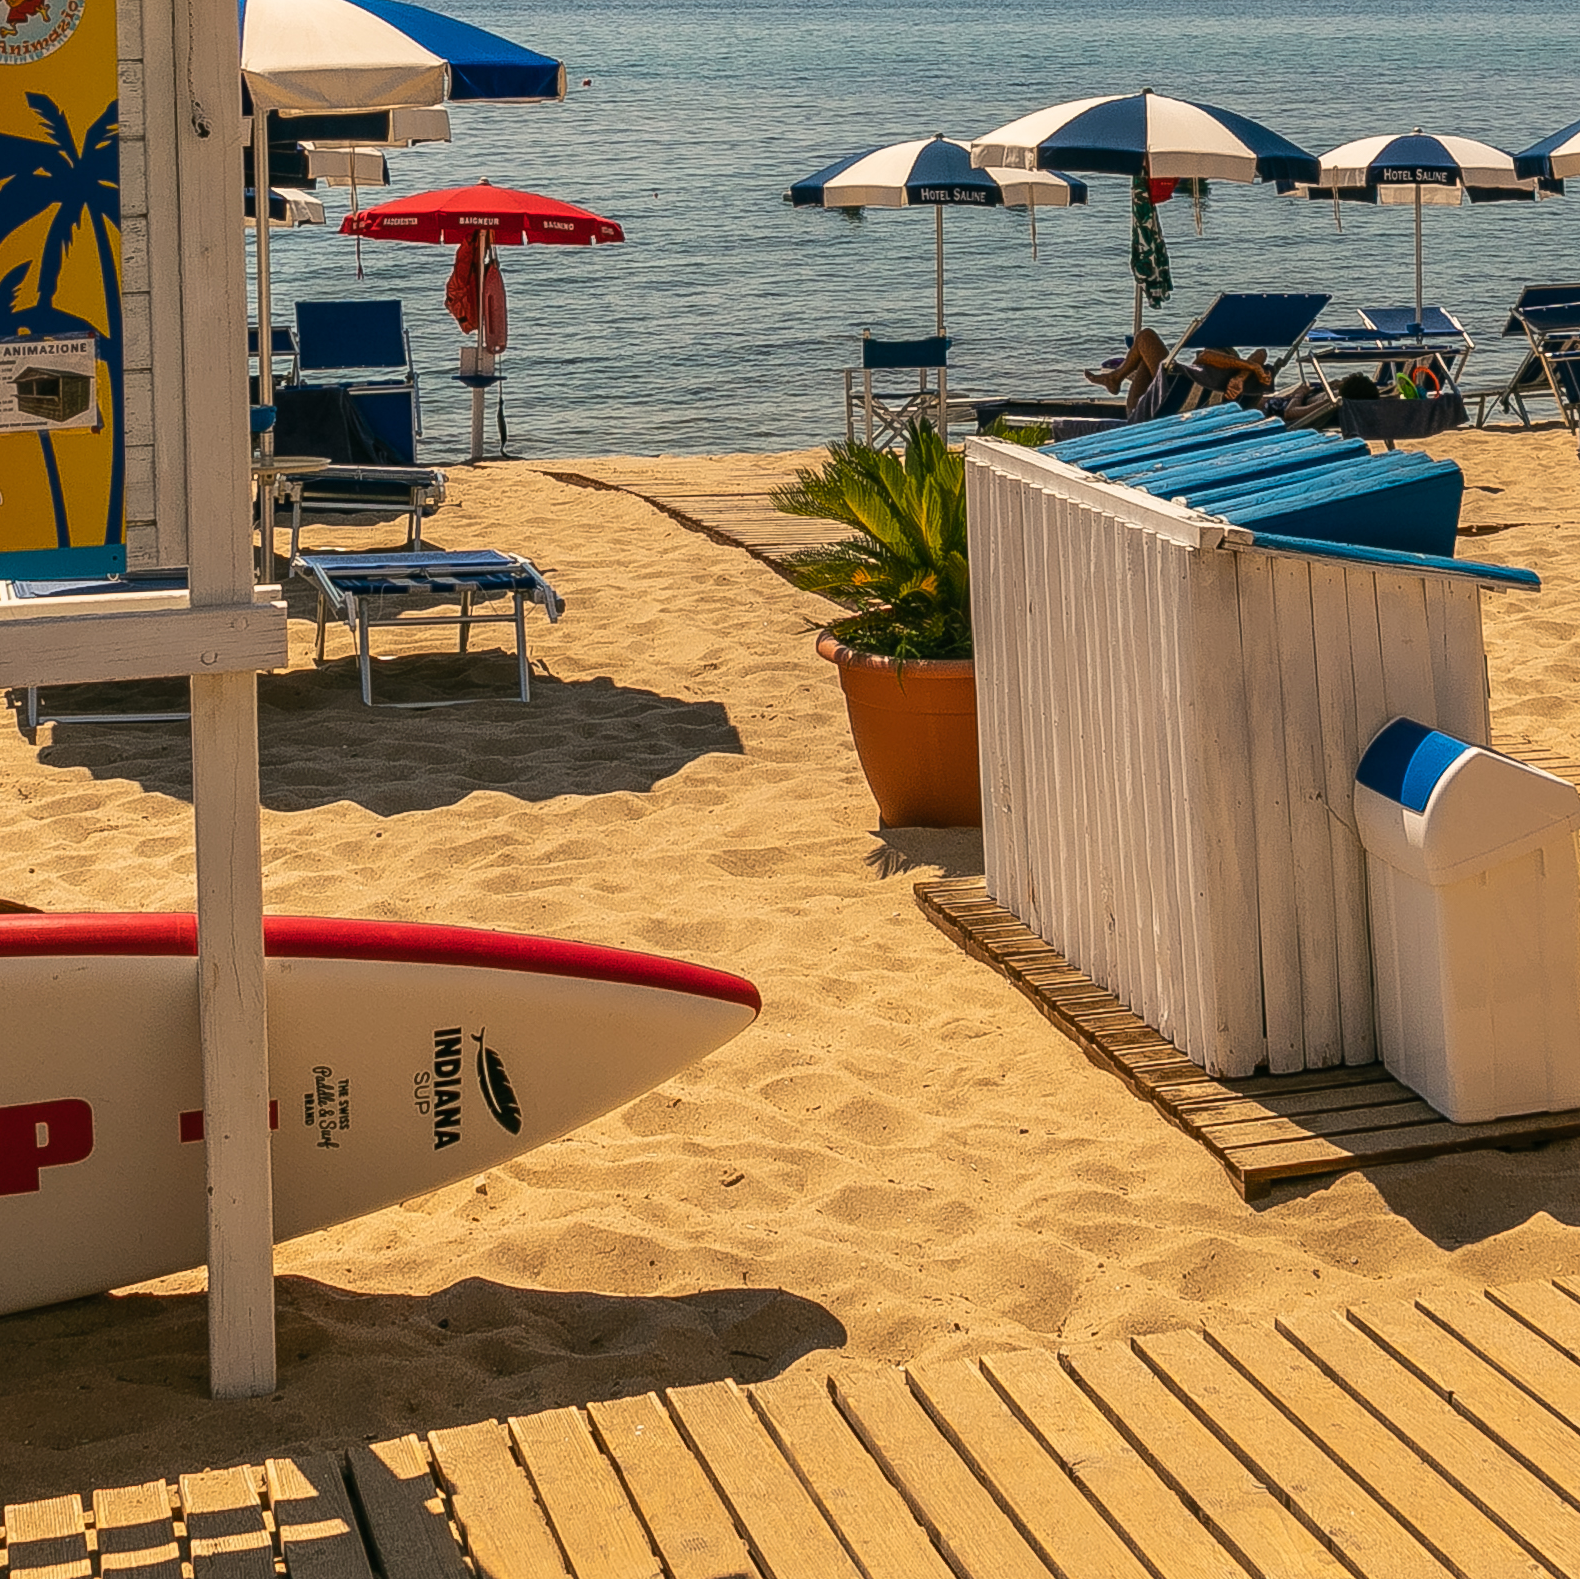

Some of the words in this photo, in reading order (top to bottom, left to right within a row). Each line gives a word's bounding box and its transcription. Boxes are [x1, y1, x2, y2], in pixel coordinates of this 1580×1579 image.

[1384, 168, 1413, 180] HOTEL
[1416, 169, 1448, 182] SALINE
[921, 188, 950, 201] HOTEL
[953, 188, 986, 202] SALINE
[459, 217, 500, 225] BAIGNEUR
[3, 343, 87, 356] ANIMAZIONE
[312, 1065, 336, 1107] Paddle
[338, 1078, 349, 1097] THE
[414, 1070, 430, 1115] SUP
[433, 1026, 462, 1151] INDIANA
[304, 1093, 315, 1126] BRAND
[339, 1099, 350, 1131] SWISS
[317, 1120, 340, 1149] Surf
